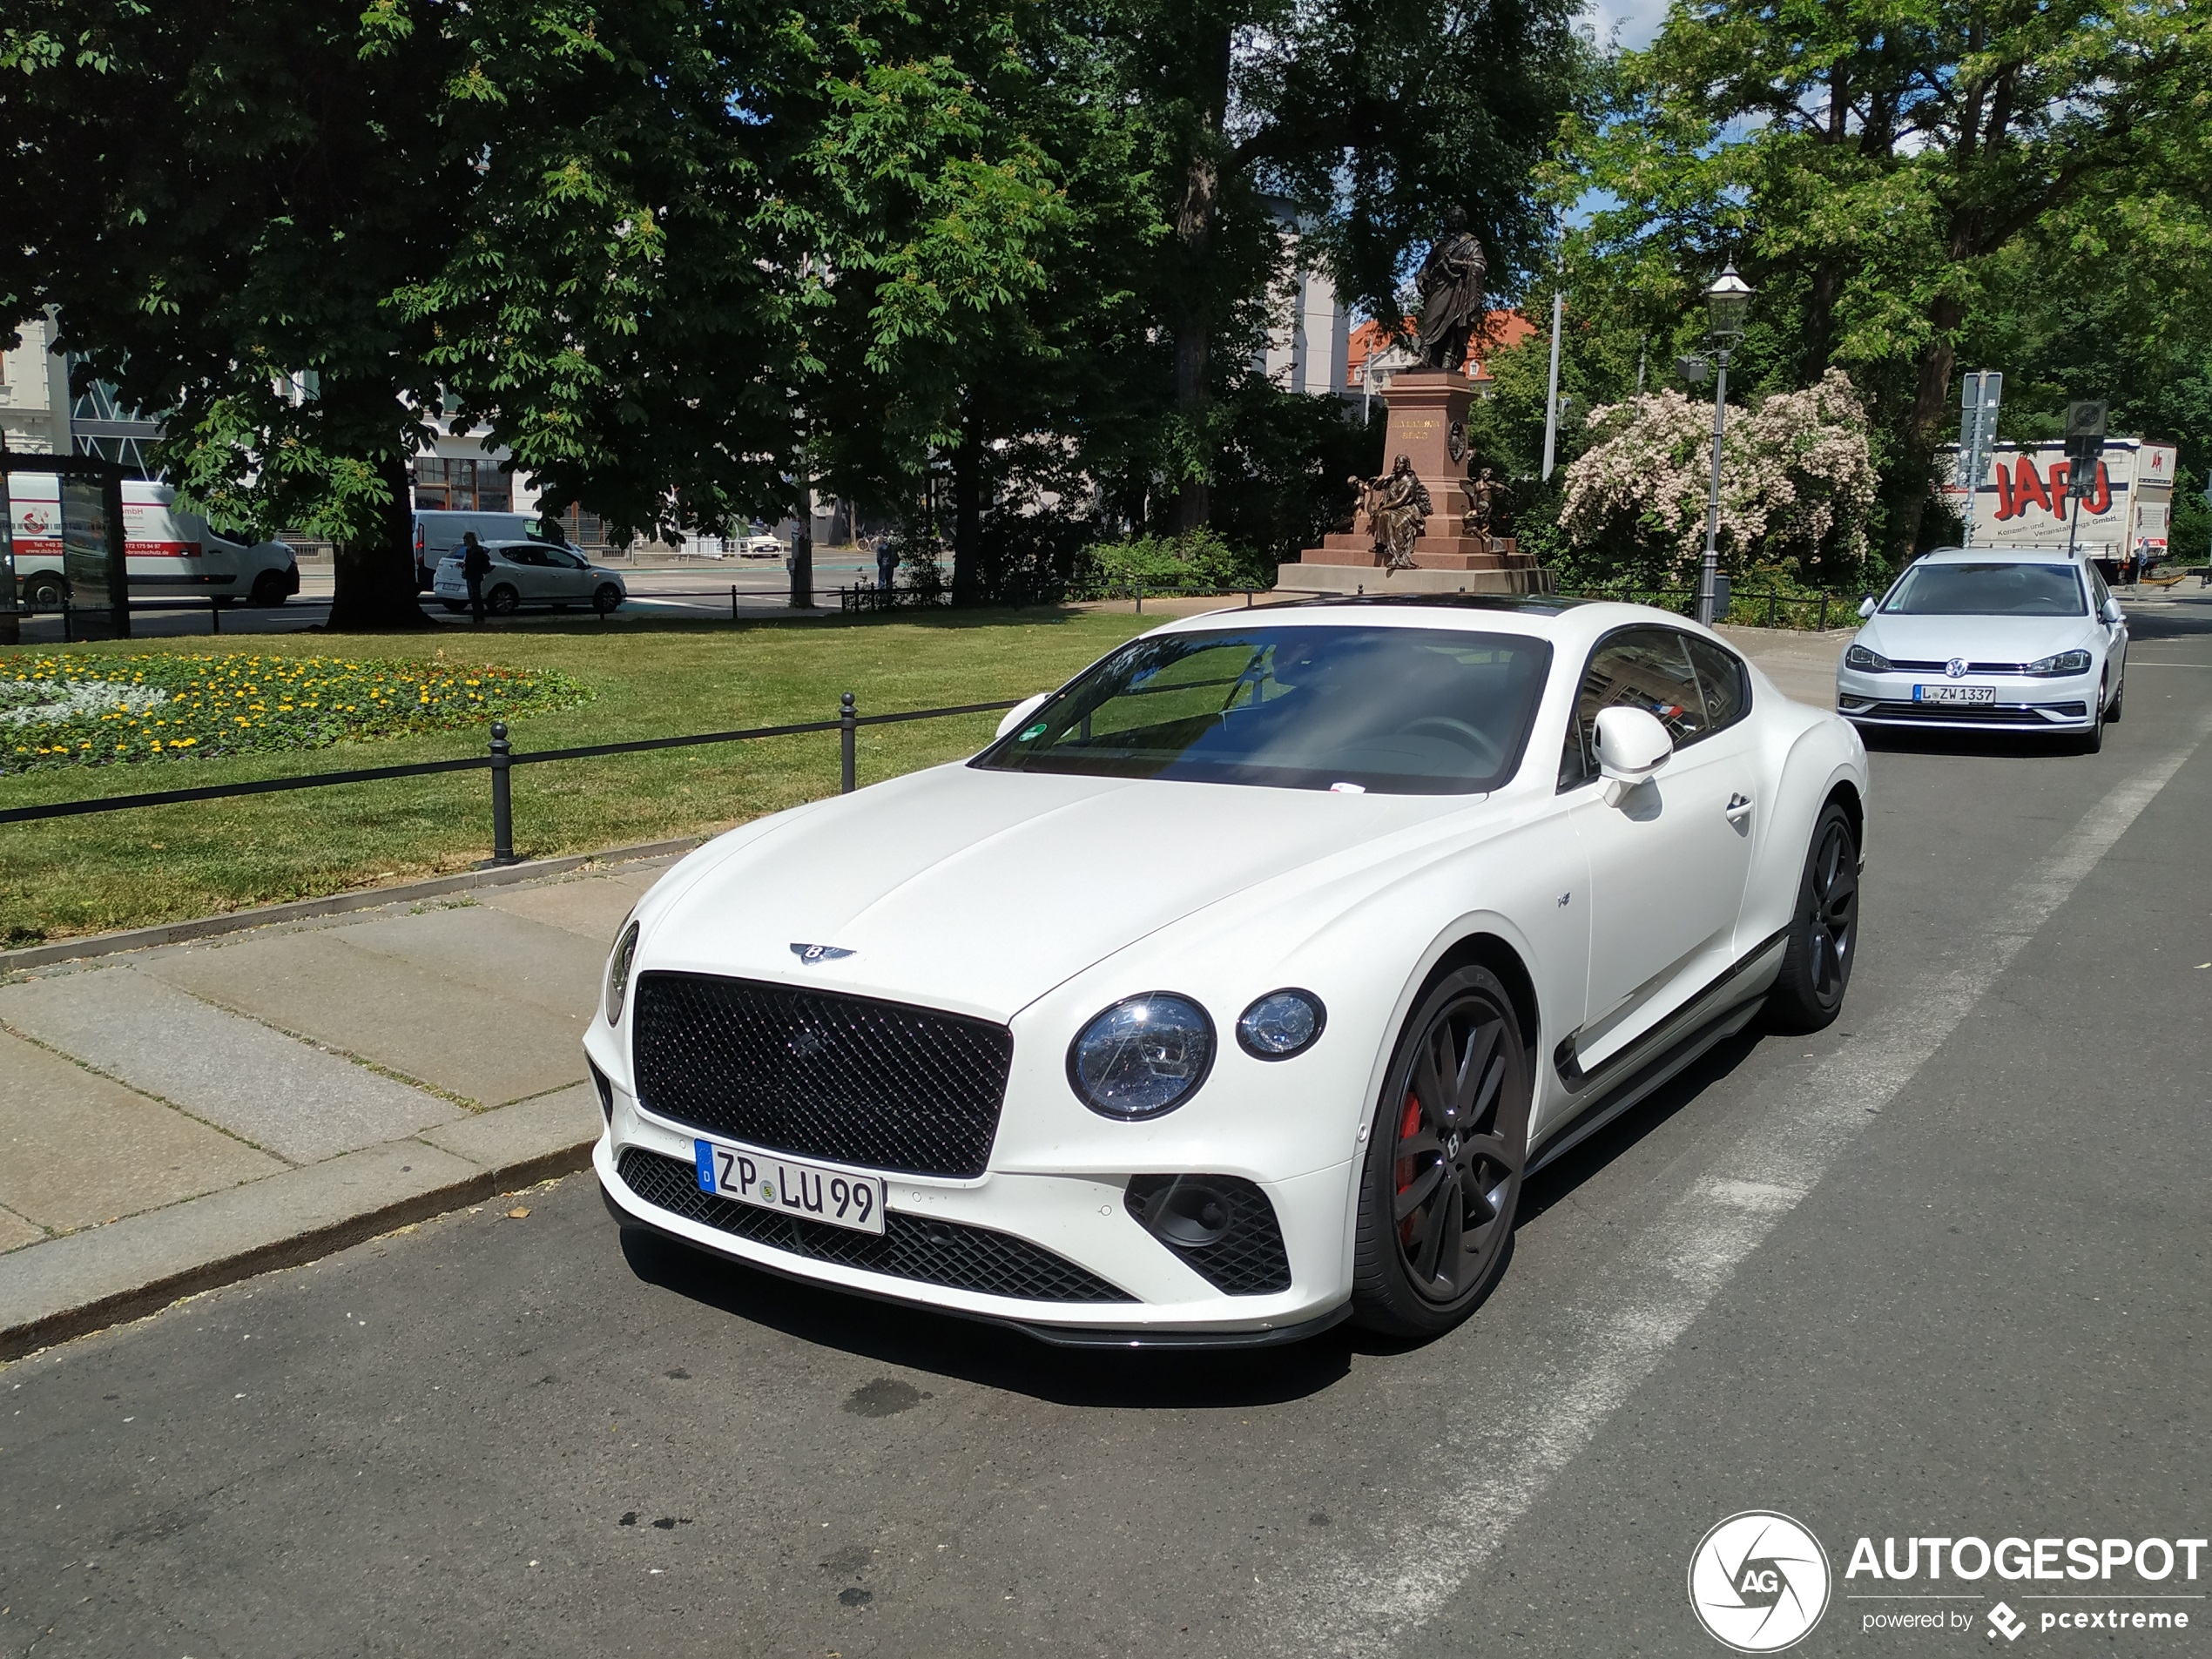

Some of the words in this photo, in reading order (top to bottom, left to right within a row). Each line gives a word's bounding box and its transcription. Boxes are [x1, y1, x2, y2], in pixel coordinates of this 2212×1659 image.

[2030, 522, 2045, 530] und
[2092, 515, 2117, 525] GmbH
[1923, 687, 1931, 699] L
[1940, 688, 1957, 700] ZW
[1959, 689, 1993, 701] 1337
[1447, 1133, 1460, 1159] B
[703, 1170, 711, 1183] D
[717, 1151, 757, 1195] ZP
[779, 1166, 824, 1214] LU
[831, 1177, 873, 1223] 99
